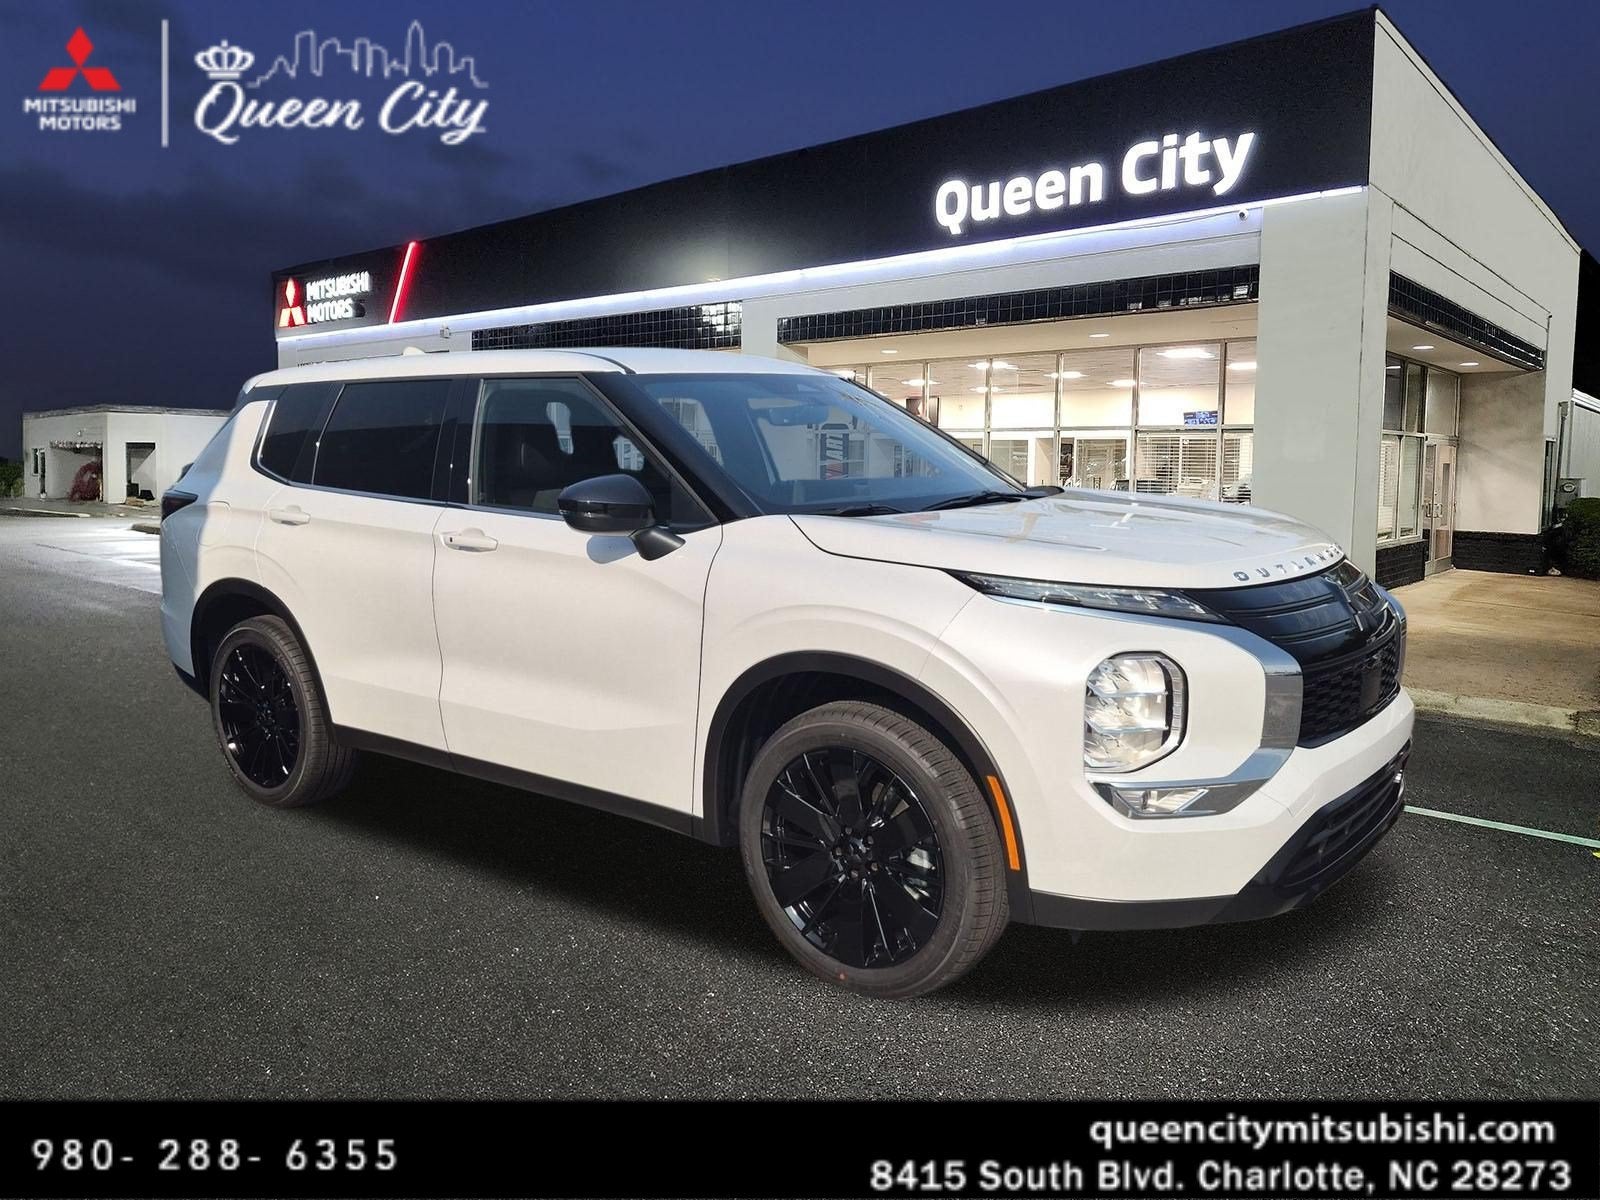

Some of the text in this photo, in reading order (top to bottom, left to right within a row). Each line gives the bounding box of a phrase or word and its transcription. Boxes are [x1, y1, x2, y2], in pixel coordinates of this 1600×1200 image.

[934, 131, 1256, 235] Queen City
[306, 270, 371, 301] MITSUBISHI
[306, 298, 356, 324] MOTORS
